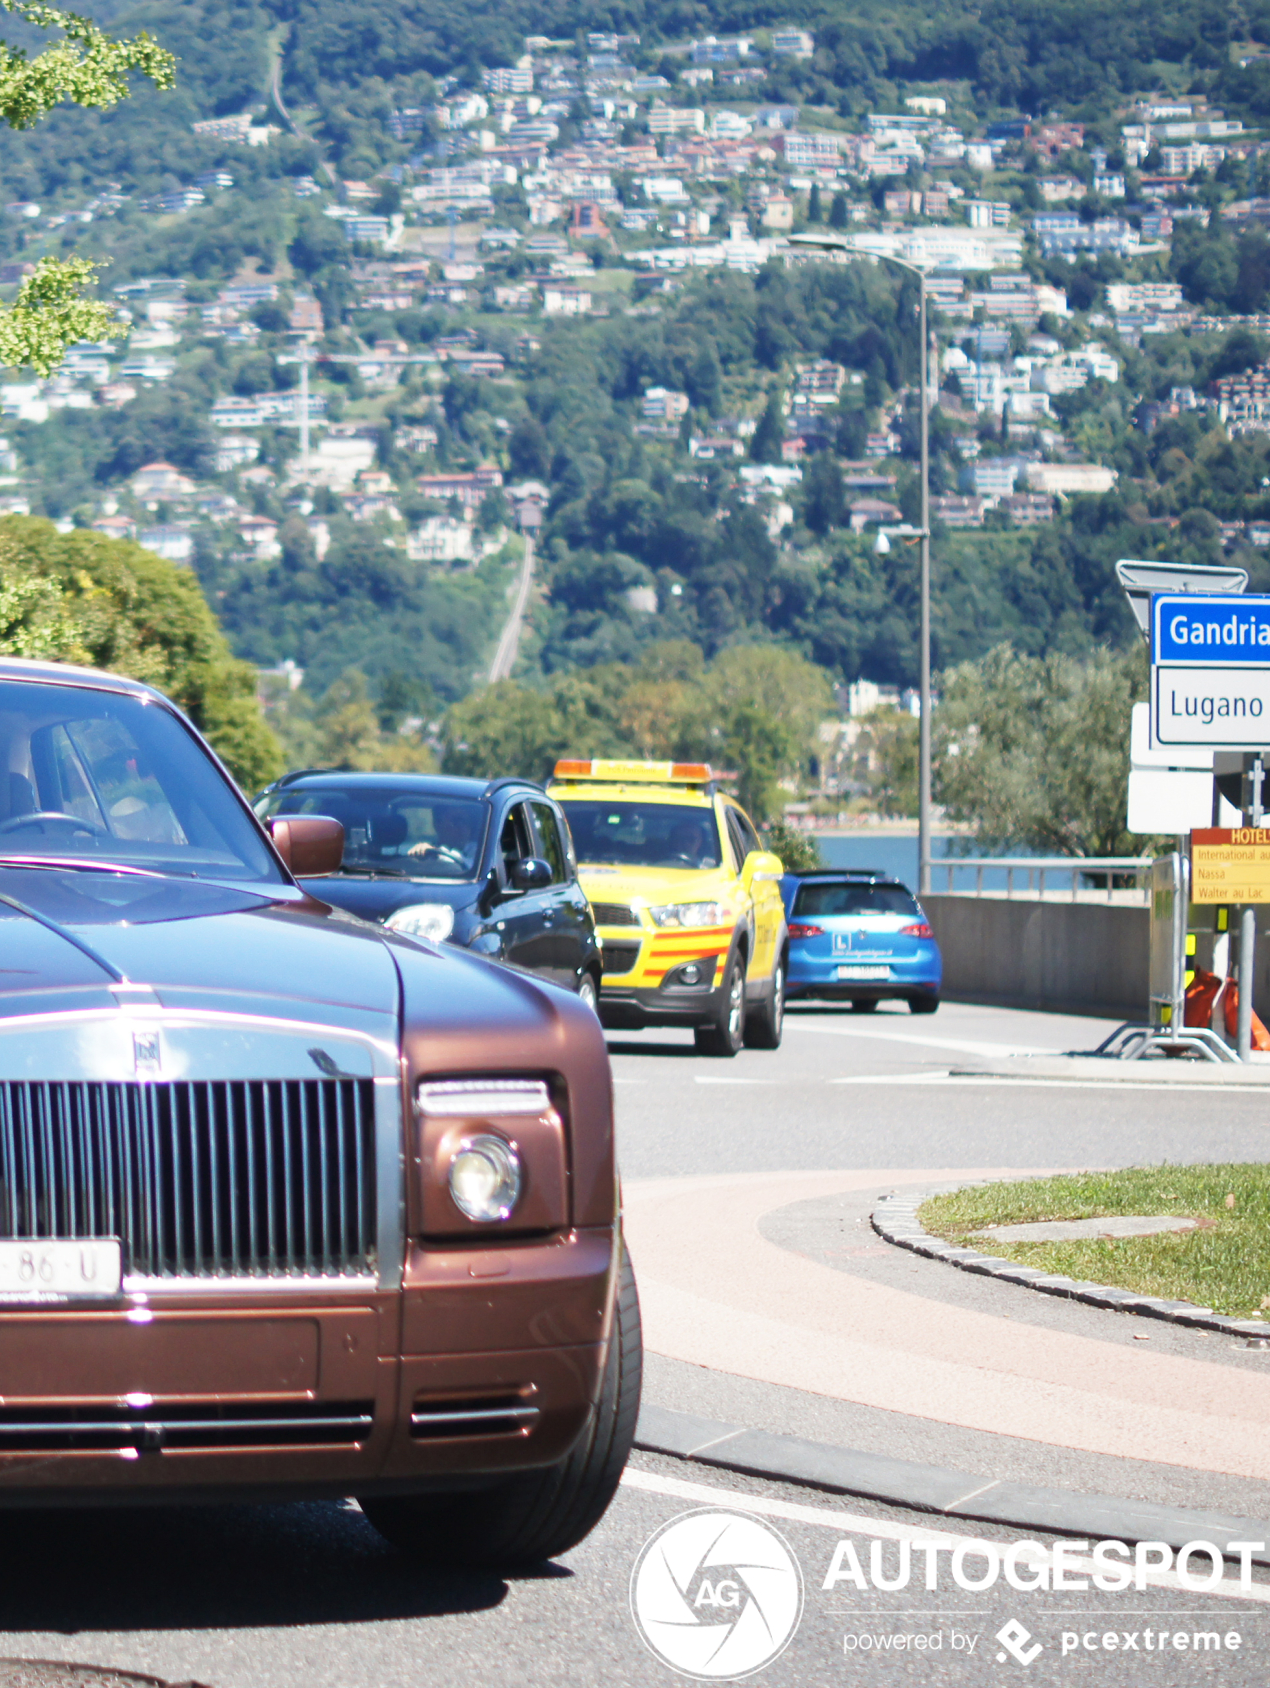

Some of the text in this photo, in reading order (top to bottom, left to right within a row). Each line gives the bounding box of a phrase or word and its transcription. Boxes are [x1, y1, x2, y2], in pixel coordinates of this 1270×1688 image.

[1170, 614, 1270, 646] Gandria
[1171, 689, 1263, 724] Lugano
[1231, 828, 1270, 844] HOTEL
[1198, 848, 1256, 860] International
[1198, 868, 1225, 879] Nassa
[1198, 887, 1262, 898] Walter au Lac
[80, 1248, 98, 1283] U
